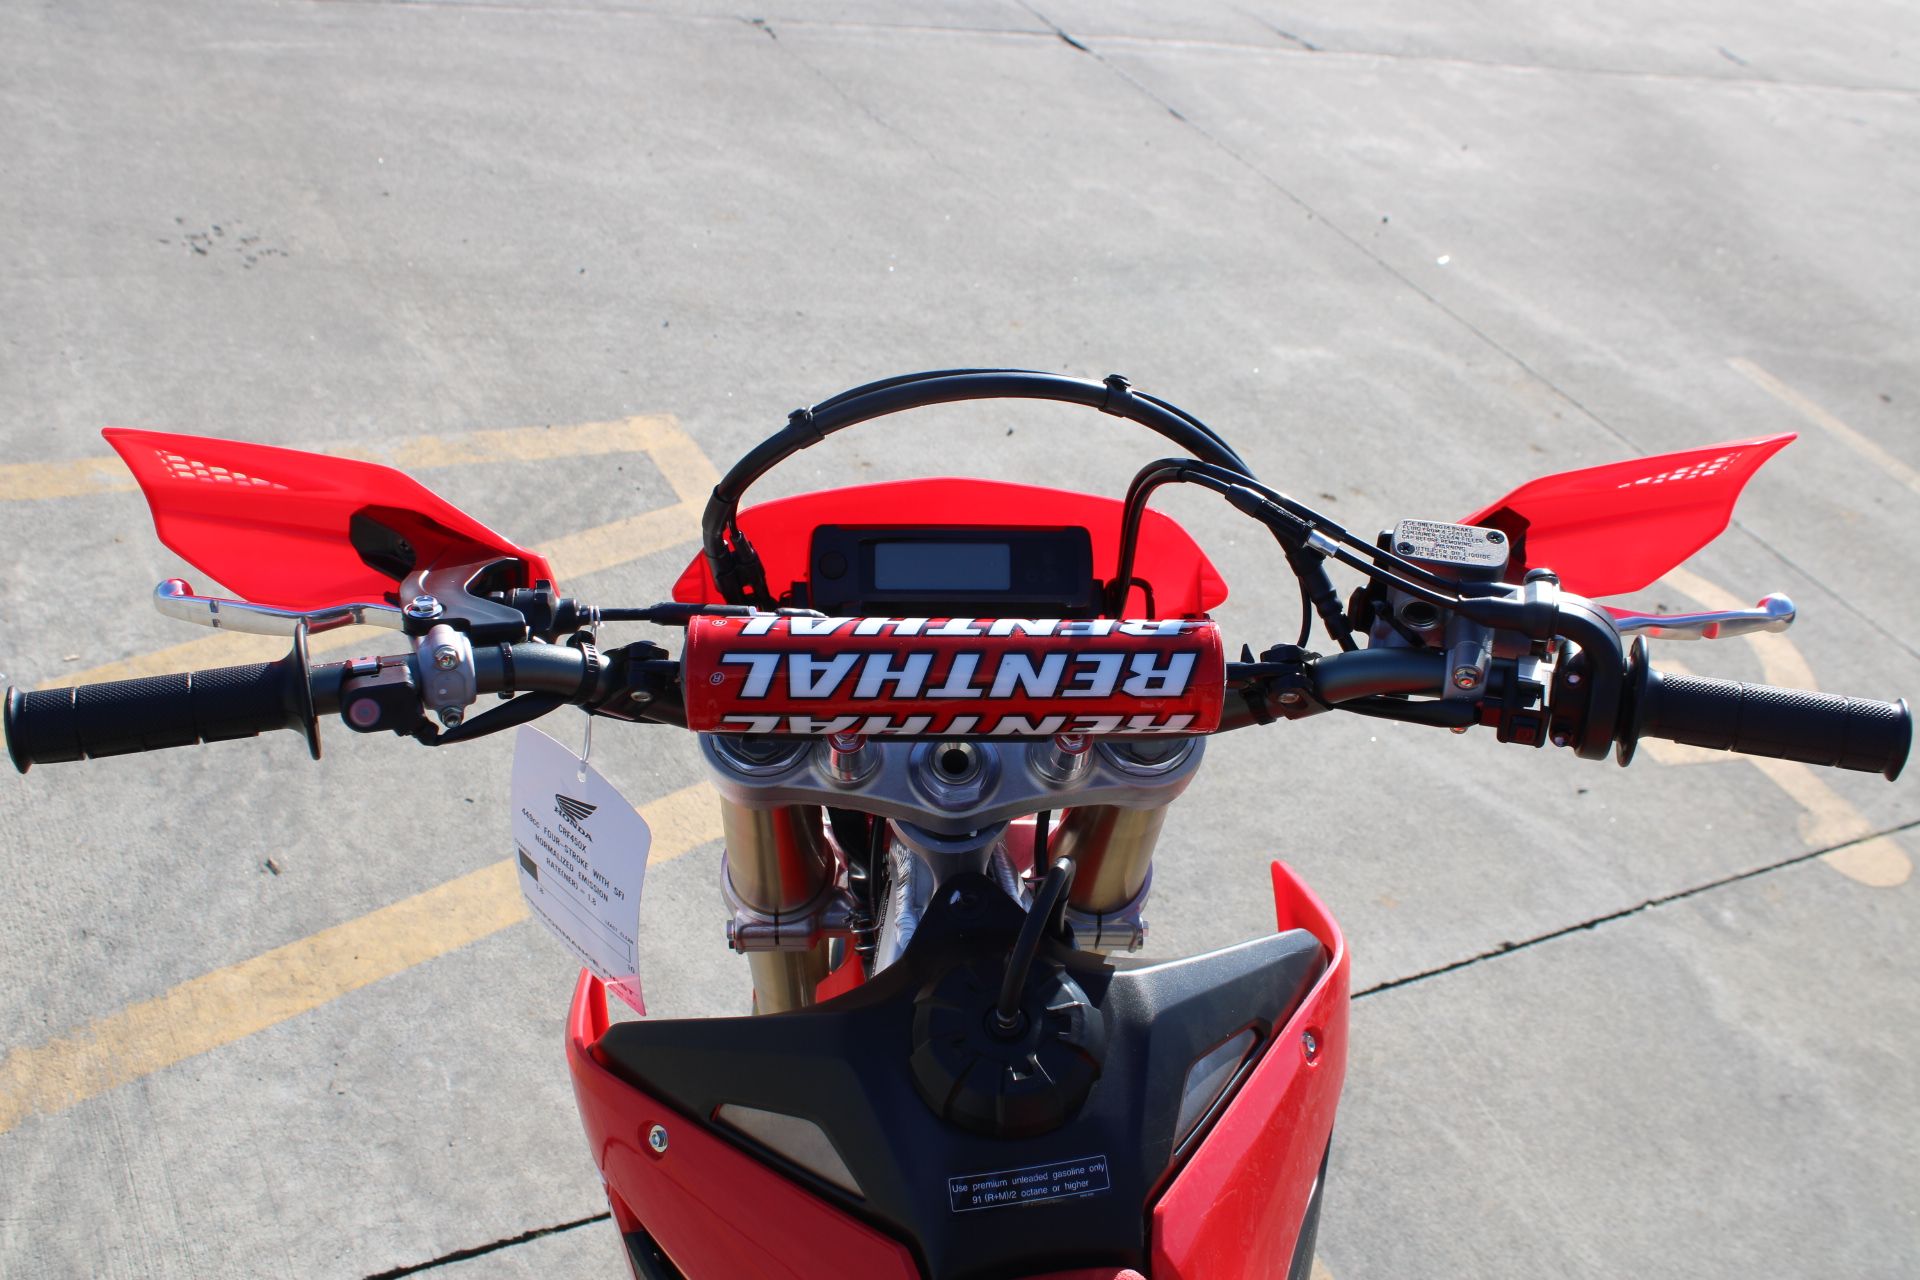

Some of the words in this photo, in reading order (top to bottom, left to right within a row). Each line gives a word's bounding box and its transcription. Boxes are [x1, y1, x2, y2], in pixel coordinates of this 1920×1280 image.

[720, 652, 1198, 699] RENTHAL
[554, 806, 593, 842] HONDA
[558, 823, 588, 854] CRF450X
[535, 833, 574, 872] NORMALIZED
[578, 871, 609, 902] EMISSION
[543, 827, 589, 870] FOUR-STROKE
[592, 868, 610, 889] WITH
[613, 886, 625, 901] SFI
[952, 1184, 968, 1193] Use
[972, 1179, 1008, 1192] premium
[1011, 1171, 1049, 1185] unleaded
[1052, 1167, 1085, 1180] gasoline
[1089, 1163, 1105, 1173] only
[972, 1195, 982, 1204] 91
[984, 1190, 1017, 1203] (R+M)/2
[1020, 1187, 1049, 1198] octane
[1052, 1185, 1061, 1193] or
[1064, 1180, 1089, 1191] higher
